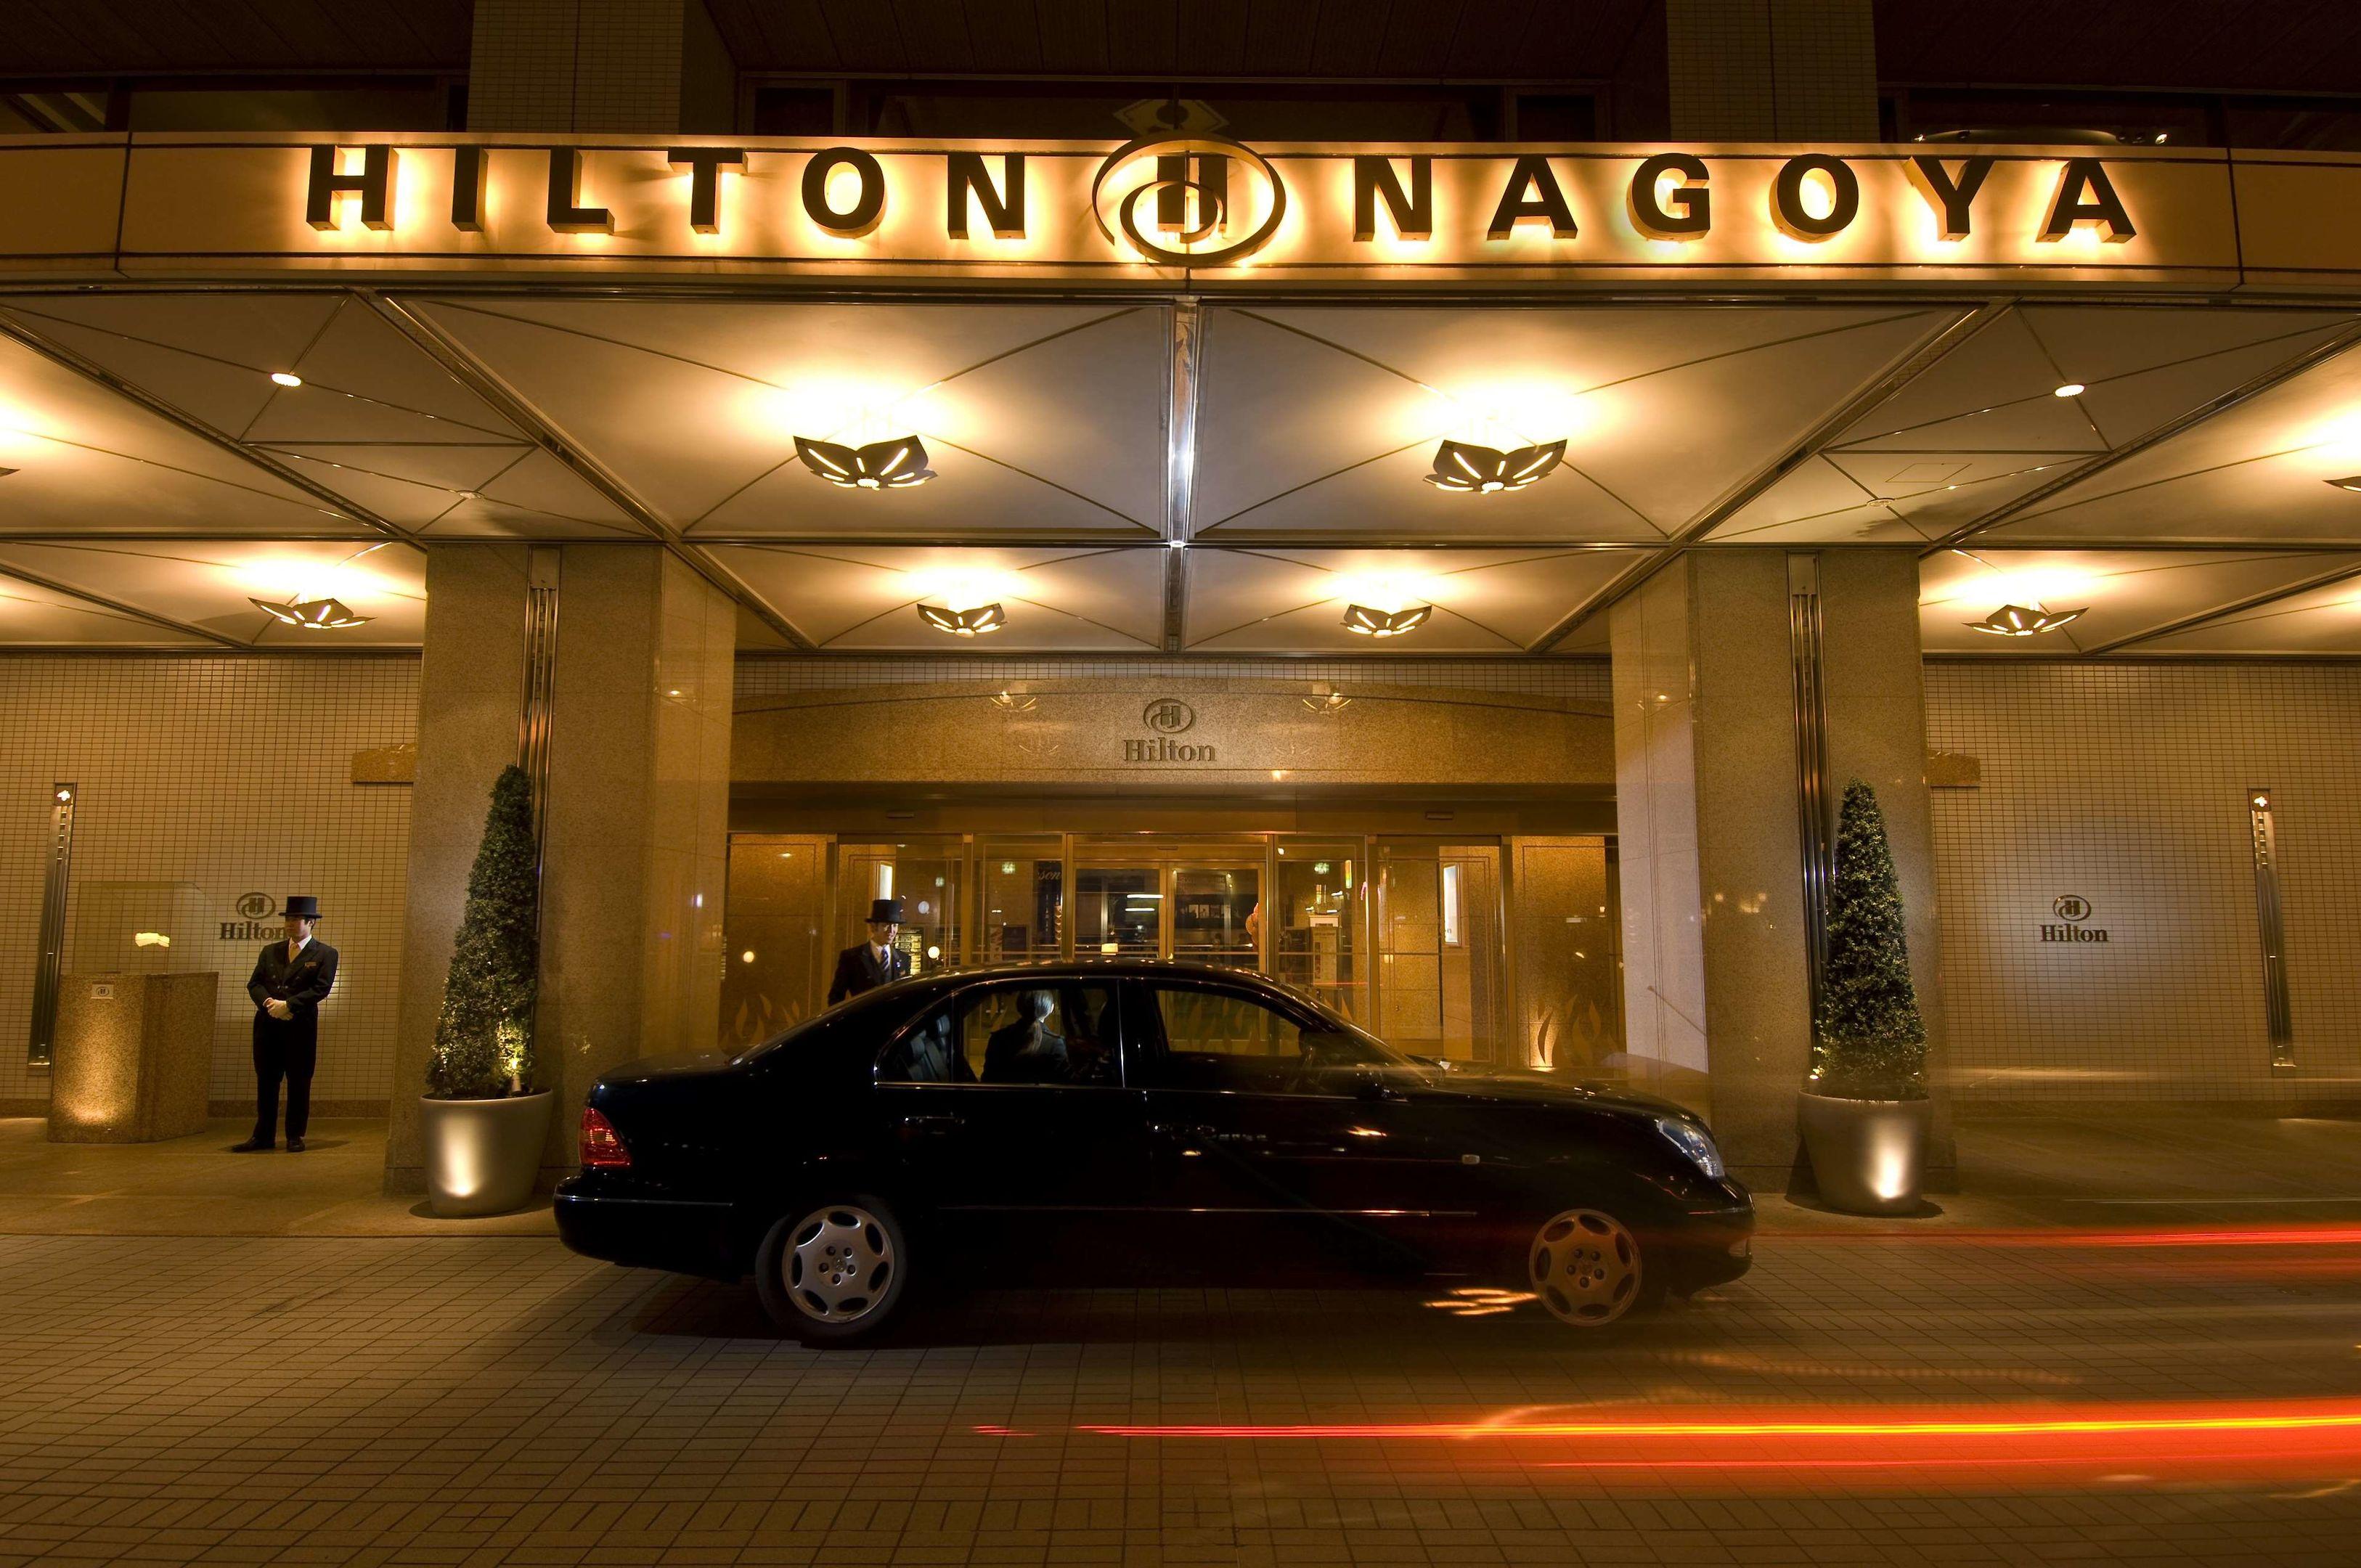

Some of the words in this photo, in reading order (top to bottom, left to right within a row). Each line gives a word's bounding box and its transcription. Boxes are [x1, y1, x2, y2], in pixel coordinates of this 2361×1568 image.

[306, 145, 1027, 239] HILTON
[1353, 152, 2137, 245] NAGOYA
[1123, 737, 1218, 761] Hilton
[2039, 923, 2109, 942] Hilton
